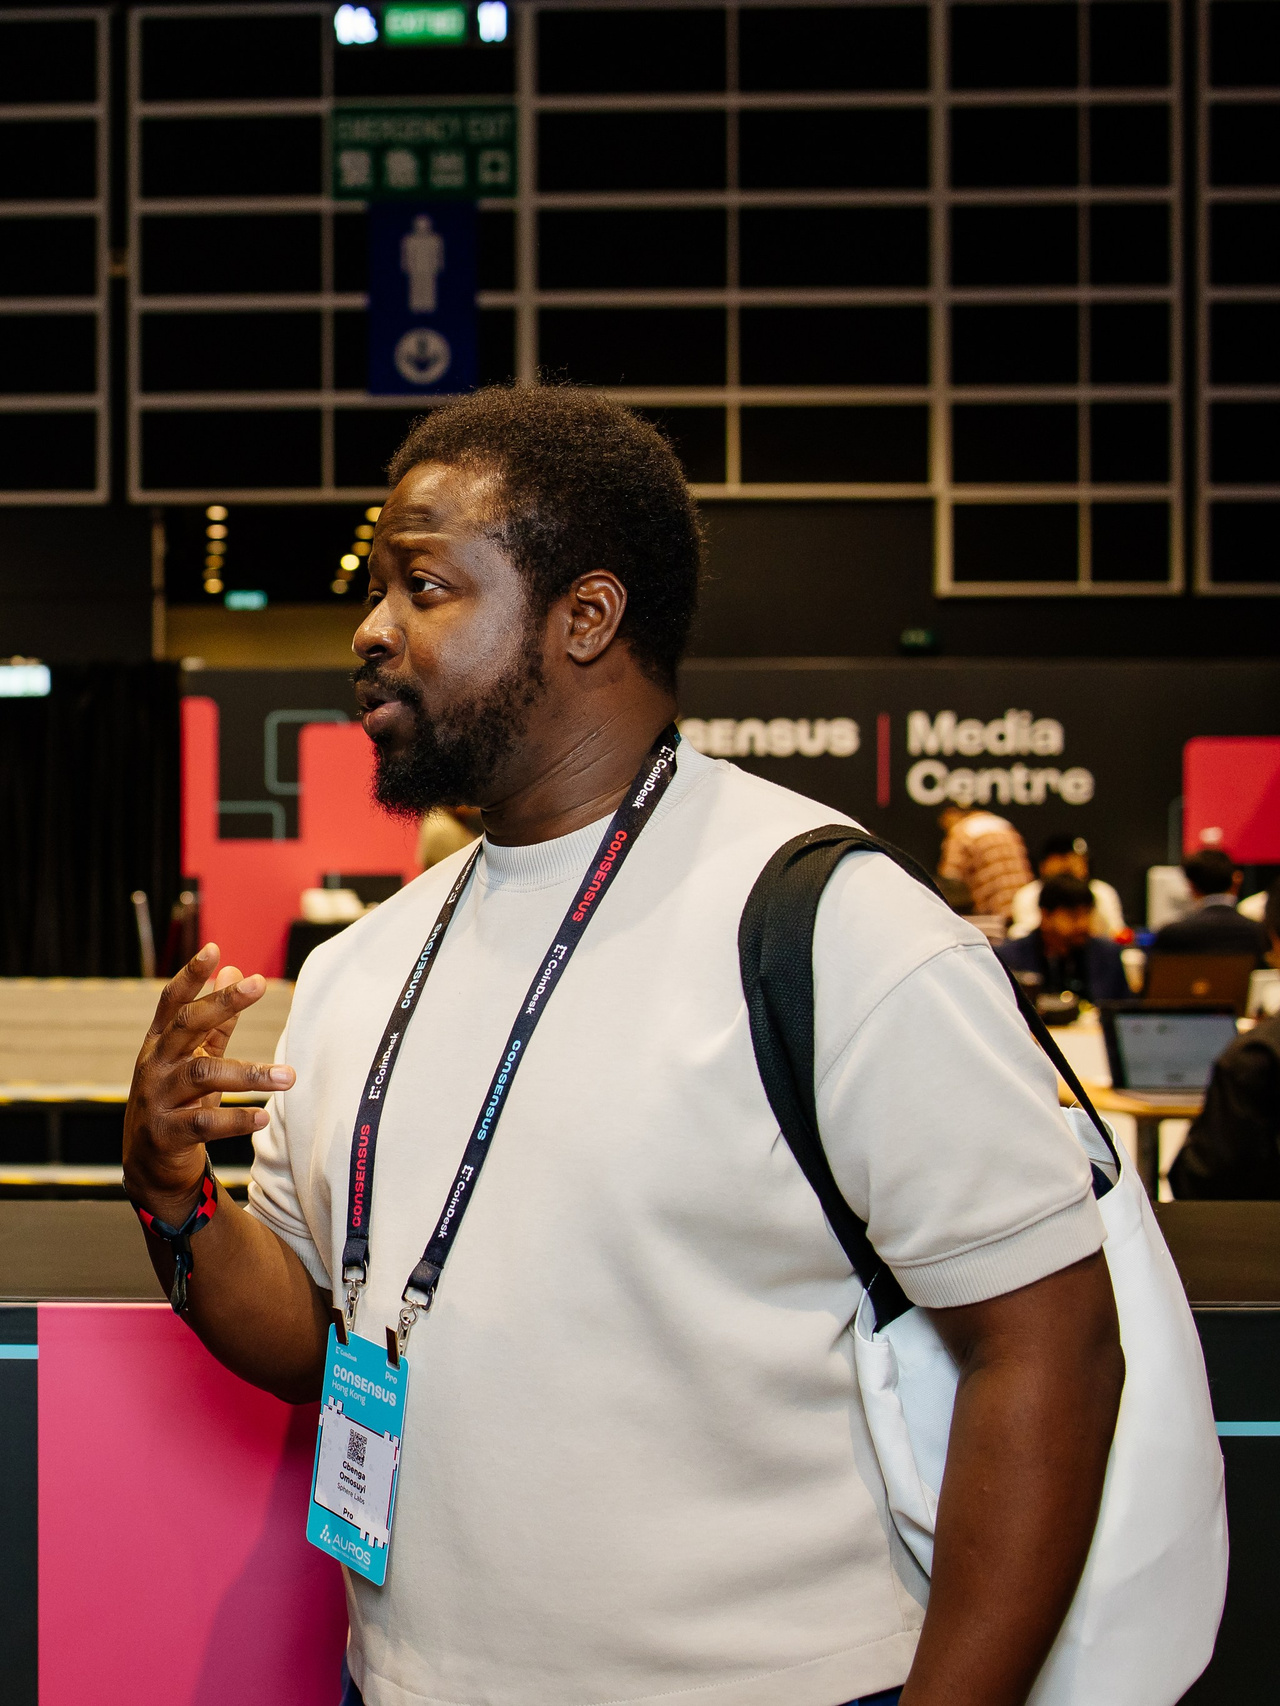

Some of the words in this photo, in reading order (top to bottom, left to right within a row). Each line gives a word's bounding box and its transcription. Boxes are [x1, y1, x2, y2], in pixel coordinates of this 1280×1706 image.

[906, 708, 1065, 757] Media
[632, 758, 667, 809] CoinDesk
[906, 759, 1095, 805] Centre
[572, 830, 628, 922] CONSENSUS
[401, 923, 442, 1009] CONSENSUS
[526, 959, 558, 1015] CoinDesk
[375, 1031, 399, 1084] CoinDesk
[477, 1039, 521, 1141] CONSENSUS
[352, 1124, 370, 1228] CONSENSUS
[438, 1181, 465, 1239] CoinDesk
[332, 1379, 349, 1397] Hong
[349, 1388, 366, 1406] Kong
[333, 1364, 397, 1407] CONSENSUS
[385, 1371, 398, 1384] Pro
[340, 1471, 366, 1493] Omosuyi
[343, 1461, 365, 1480] Gbenga
[343, 1507, 353, 1520] Pro
[333, 1534, 371, 1565] AUROS
